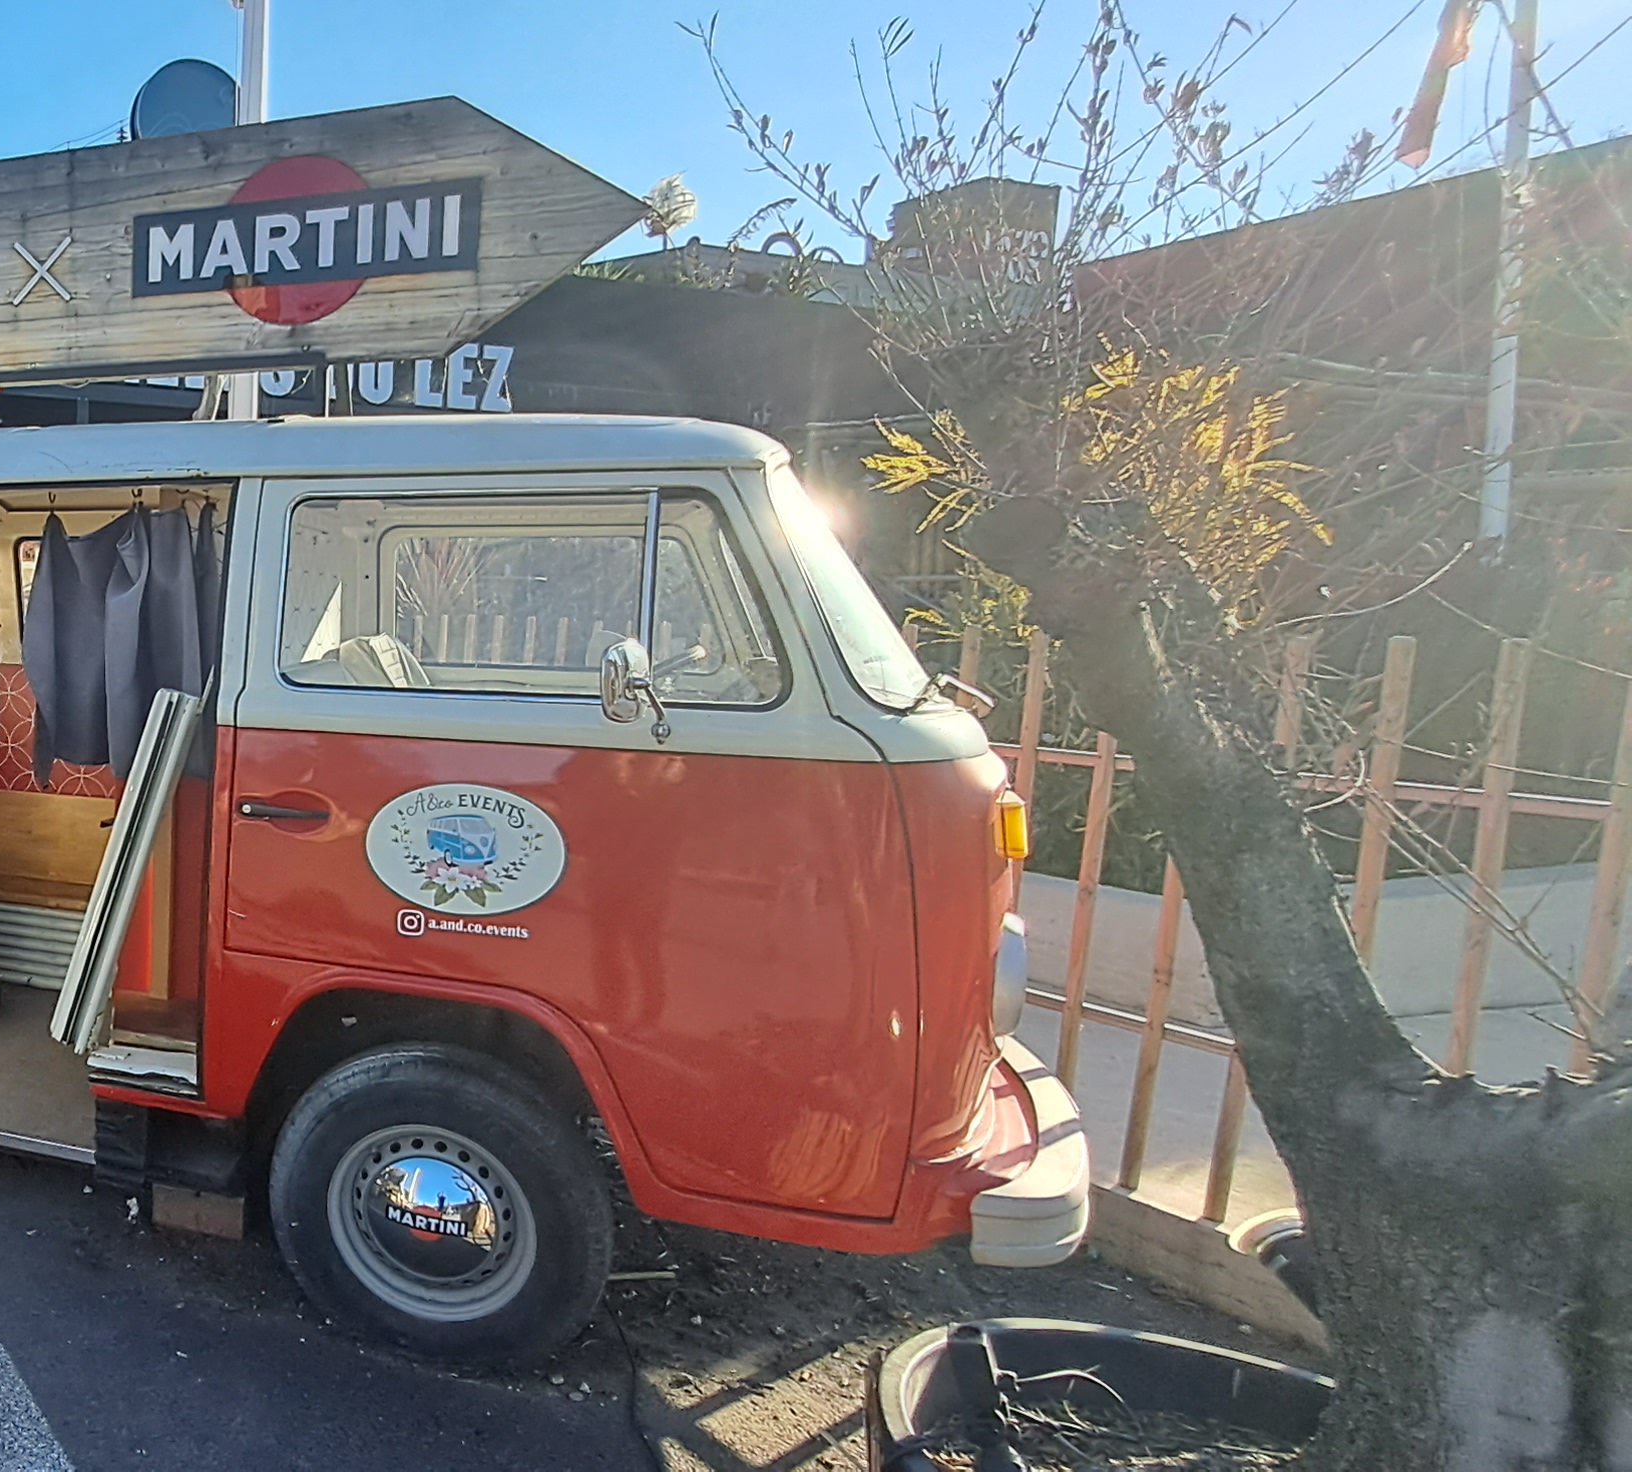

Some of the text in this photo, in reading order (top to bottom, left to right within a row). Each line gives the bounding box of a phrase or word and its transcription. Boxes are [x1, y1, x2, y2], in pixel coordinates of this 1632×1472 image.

[148, 195, 461, 283] MARTINI
[329, 361, 394, 405] U
[414, 343, 514, 413] LEZ
[457, 793, 526, 829] EVENTS
[428, 918, 529, 939] a.and.co.events
[387, 1205, 466, 1237] MARTINI
